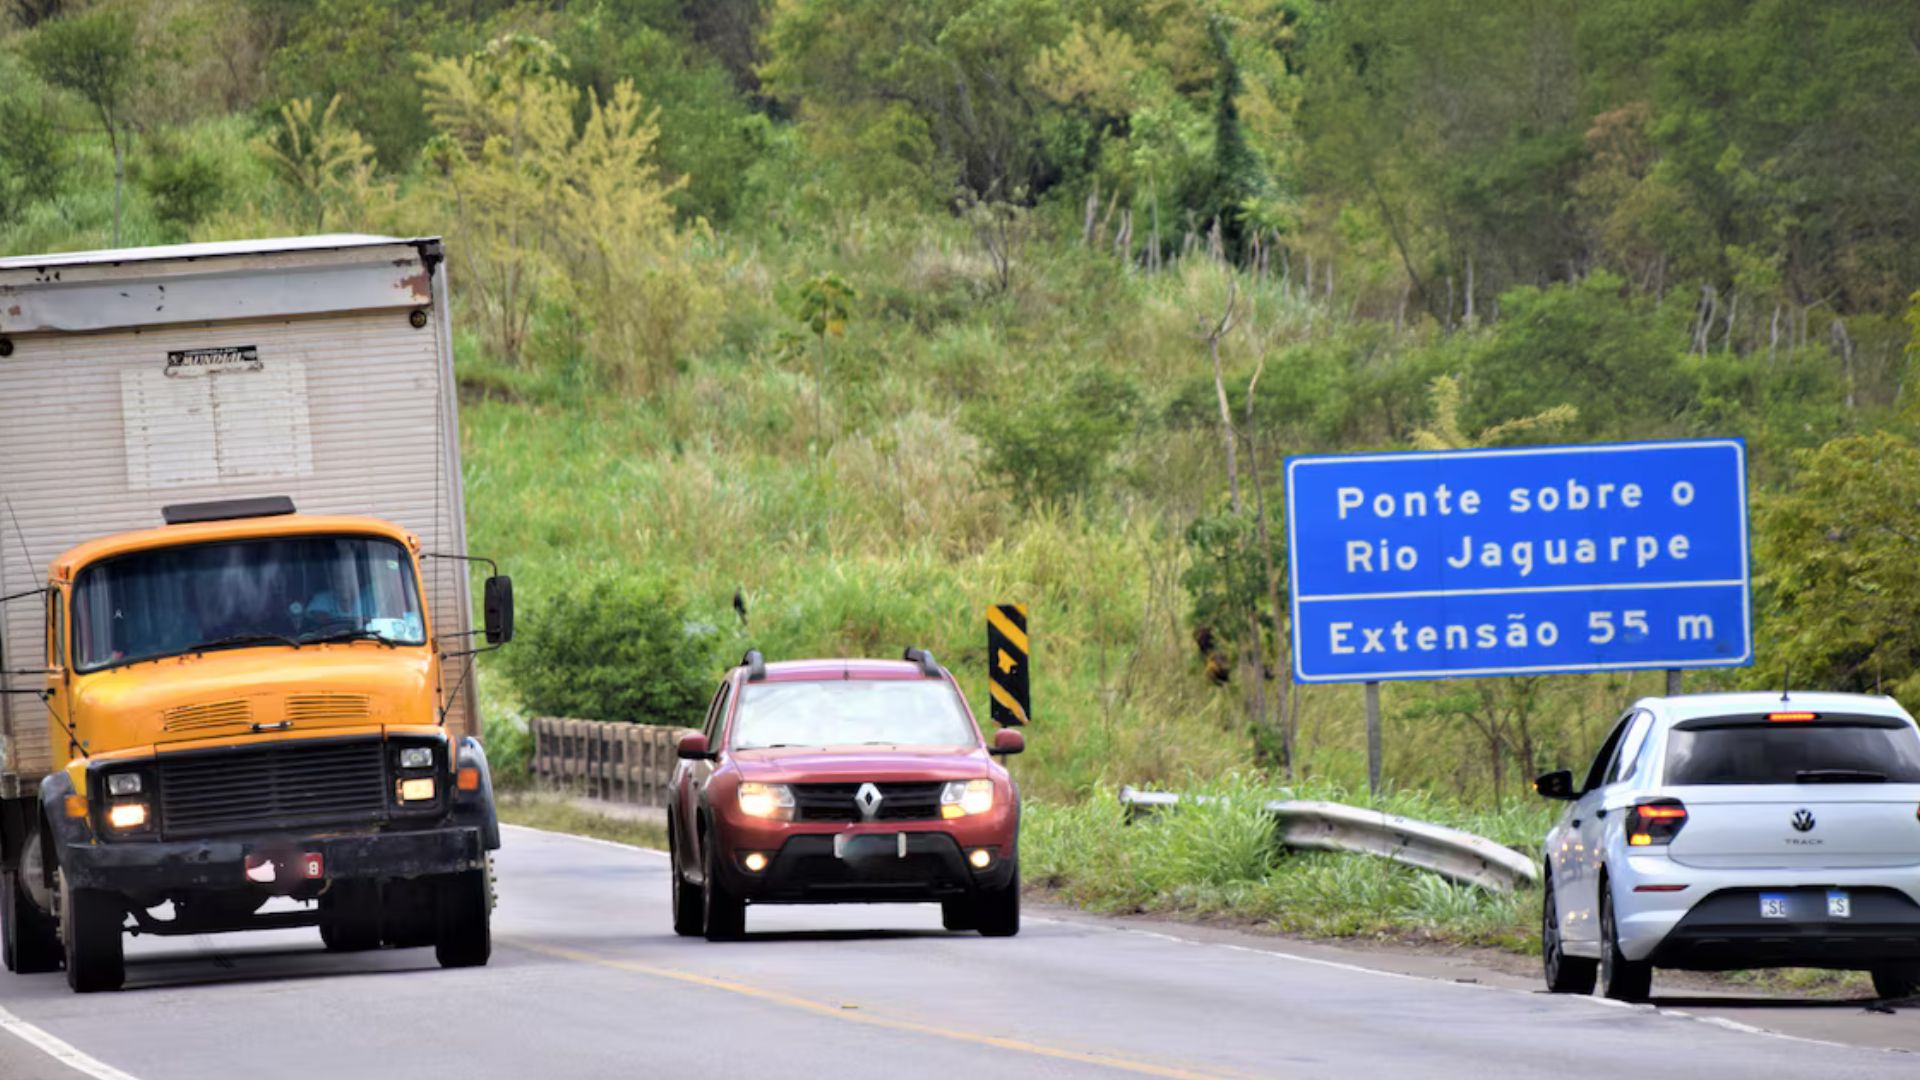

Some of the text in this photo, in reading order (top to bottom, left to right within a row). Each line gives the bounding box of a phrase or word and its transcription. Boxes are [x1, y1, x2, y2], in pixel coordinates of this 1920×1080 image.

[1336, 478, 1695, 520] Ponte sobre o
[1346, 533, 1691, 577] Rio Jaguarpe
[1329, 609, 1714, 654] Extensão 55 m
[1784, 838, 1824, 846] TRACK
